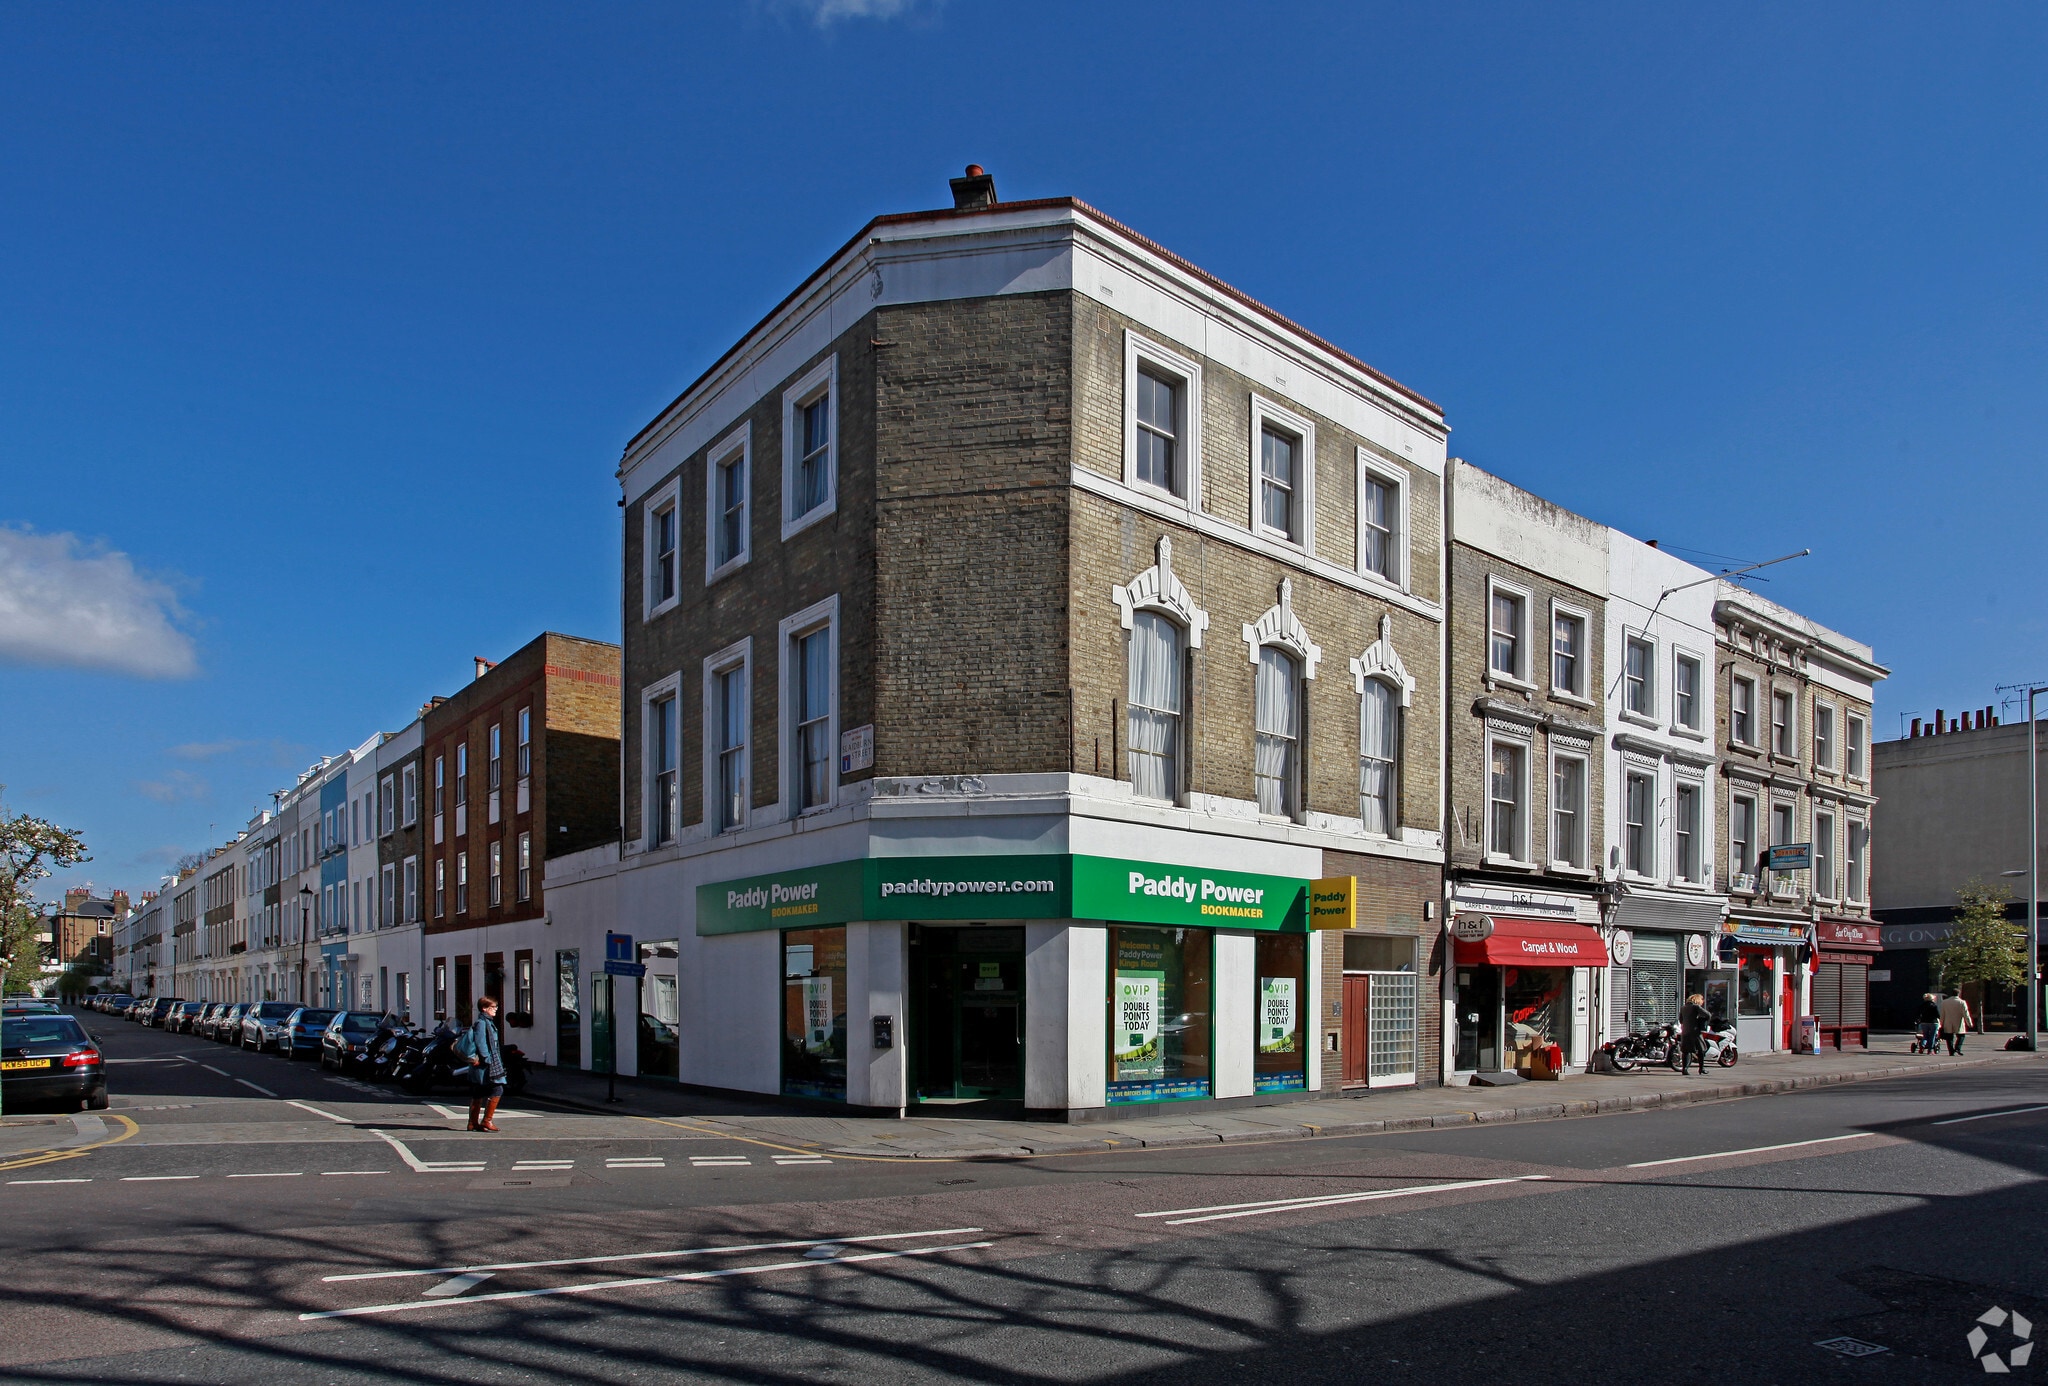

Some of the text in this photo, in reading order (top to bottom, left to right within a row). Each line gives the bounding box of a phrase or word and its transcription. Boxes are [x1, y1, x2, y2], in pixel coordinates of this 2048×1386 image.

[881, 879, 1054, 897] paddypower.com
[1129, 871, 1264, 904] Paddy Power
[727, 882, 818, 910] Paddy Power
[1313, 892, 1346, 903] Paddy
[771, 903, 818, 917] BOOKMAKER
[1201, 904, 1263, 919] BOOKMAKER
[1313, 906, 1346, 916] Power
[1909, 930, 1936, 942] ON
[1119, 941, 1151, 949] Welcome
[1521, 940, 1578, 955] Carpet & Wood
[1119, 950, 1163, 959] Paddy Power
[1119, 959, 1139, 968] Kings
[809, 1000, 827, 1008] DOUBLE
[1123, 1002, 1150, 1011] DOUBLE
[1267, 999, 1289, 1008] DOUBLE
[809, 1009, 827, 1018] POINTS
[1123, 1011, 1150, 1021] POINTS
[1267, 1008, 1289, 1016] POINTS
[810, 1018, 827, 1027] TODAY
[1124, 1021, 1150, 1030] TODAY
[1267, 1017, 1289, 1025] TODAY
